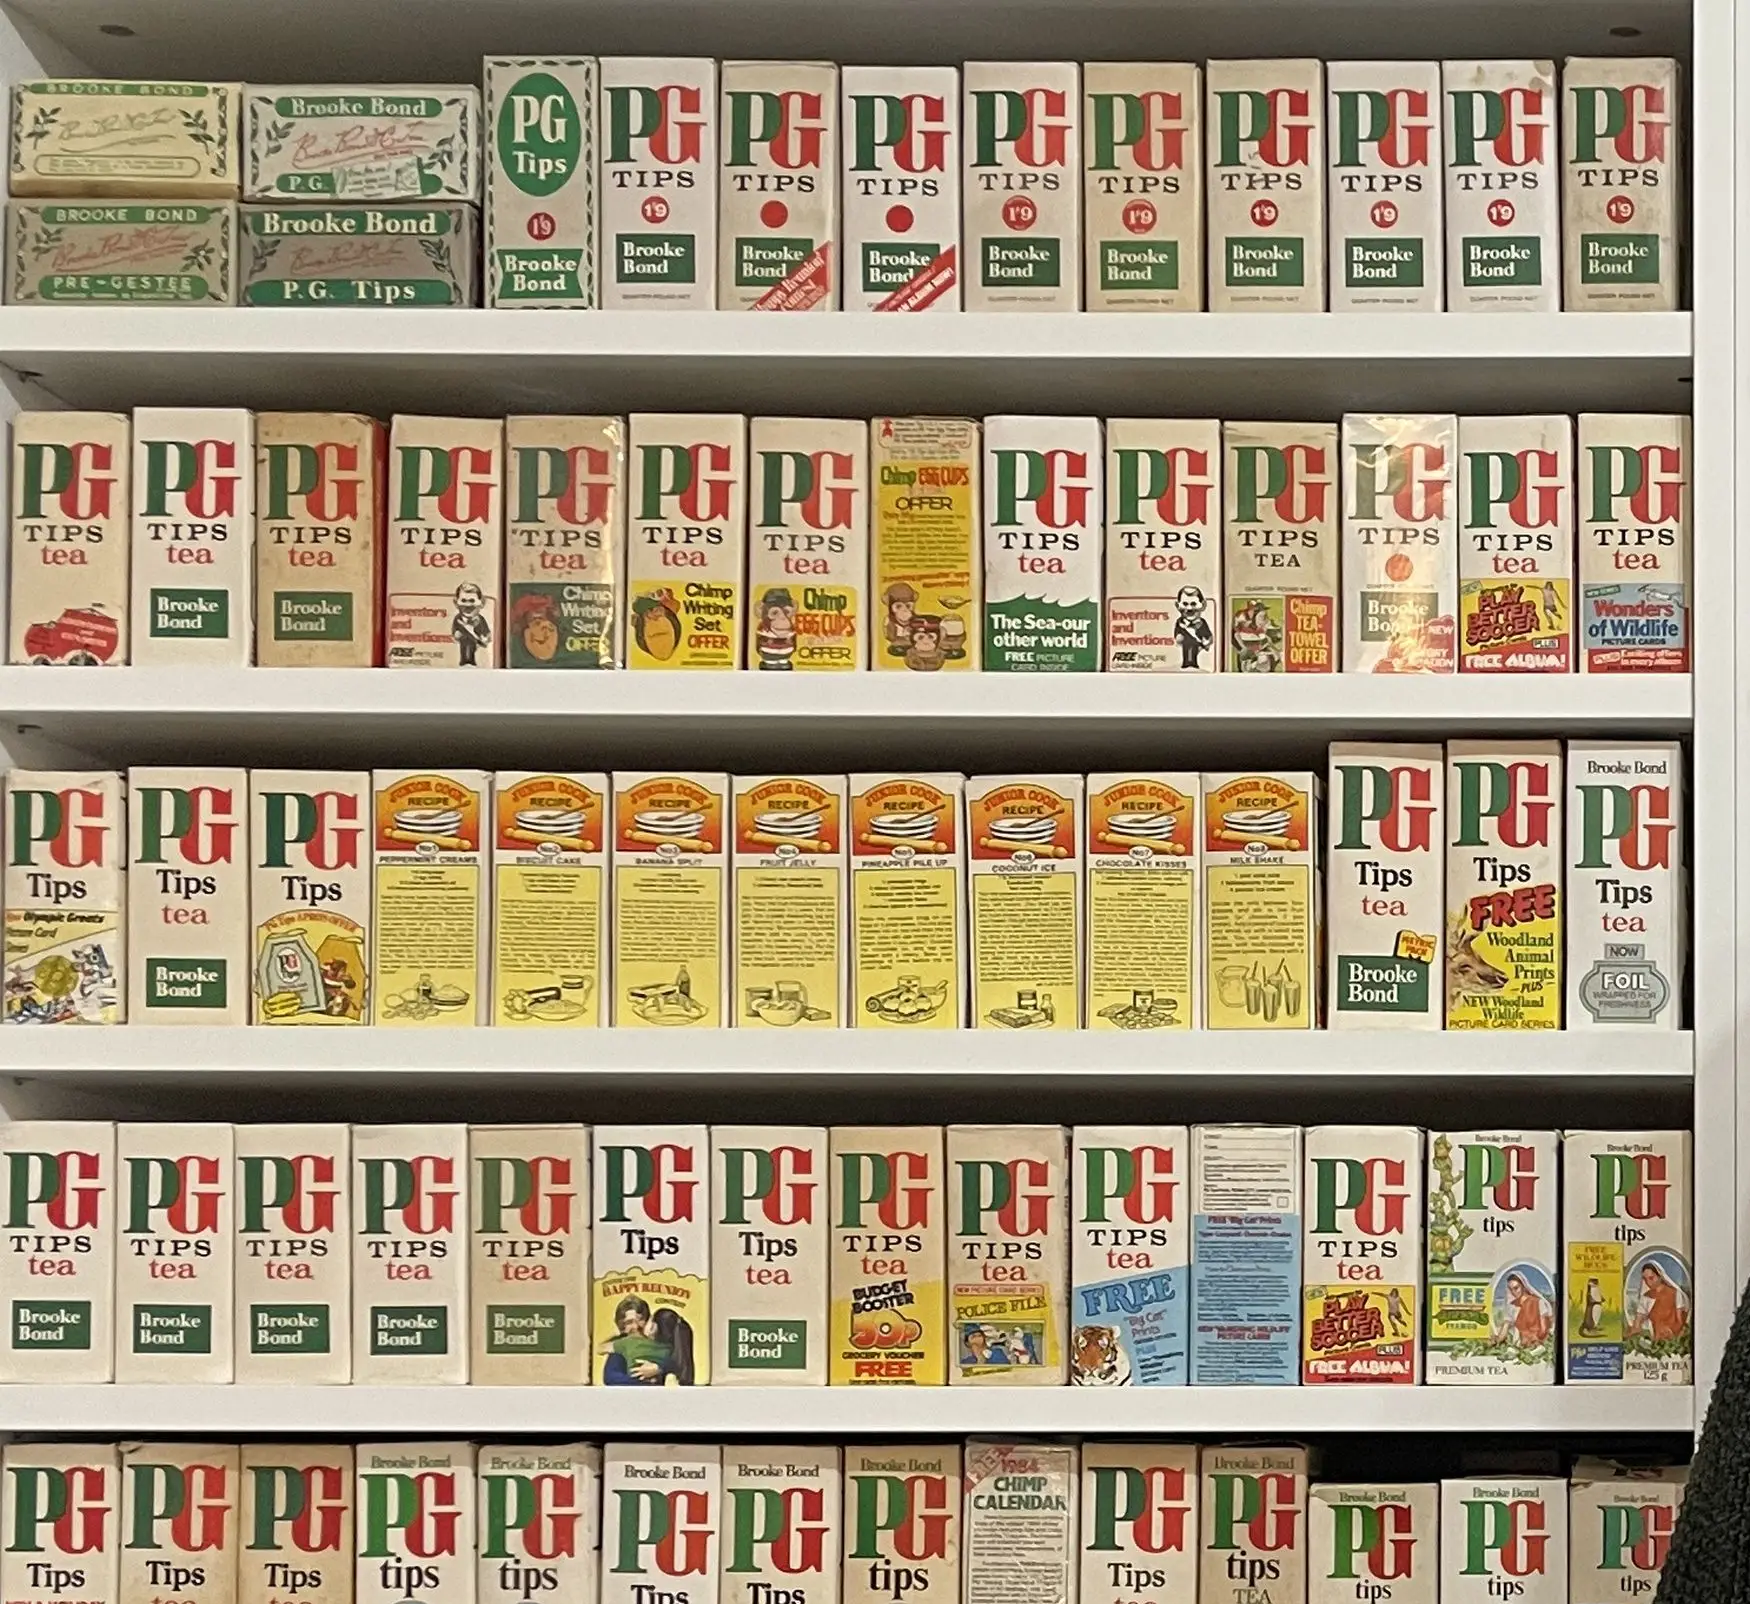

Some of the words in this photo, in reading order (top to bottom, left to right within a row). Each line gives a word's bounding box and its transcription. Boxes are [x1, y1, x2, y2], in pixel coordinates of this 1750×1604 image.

[290, 96, 364, 119] Brooke
[370, 96, 428, 117] Bond
[605, 85, 707, 166] PG
[612, 170, 695, 189] TIPS
[143, 207, 198, 222] BOND
[261, 212, 360, 236] Brooke
[365, 212, 437, 235] Bond
[283, 281, 333, 302] P.G.
[350, 281, 416, 303] Tips
[147, 523, 229, 542] TIPS
[685, 584, 733, 600] Chimp
[1594, 600, 1674, 618] Wonders
[693, 617, 722, 632] Set
[991, 614, 1020, 631] The
[1023, 614, 1091, 631] Sea-our
[1588, 621, 1607, 640] of
[1611, 620, 1678, 639] Wildlife
[688, 634, 730, 649] OFFER
[993, 632, 1037, 649] other
[1040, 632, 1087, 649] world
[1005, 651, 1034, 663] FREE
[1587, 761, 1629, 776] Brooke
[1633, 761, 1667, 775] Bond
[1335, 764, 1441, 853] PG
[1038, 863, 1057, 873] ICE
[1470, 884, 1556, 931] FREE
[1486, 933, 1554, 948] Woodland
[1505, 949, 1554, 965] Animal
[1609, 946, 1639, 959] NOW
[1347, 964, 1417, 984] Brooke
[1515, 963, 1555, 982] Prints
[1602, 972, 1650, 991] FOIL
[1347, 984, 1400, 1005] Bond
[1083, 1274, 1176, 1318] FREE
[956, 1298, 1005, 1318] POLICE
[854, 1361, 913, 1378] FREE
[1488, 1366, 1510, 1376] TEA
[993, 1476, 1048, 1493] CHIMP
[973, 1493, 1067, 1512] CALENDAR
